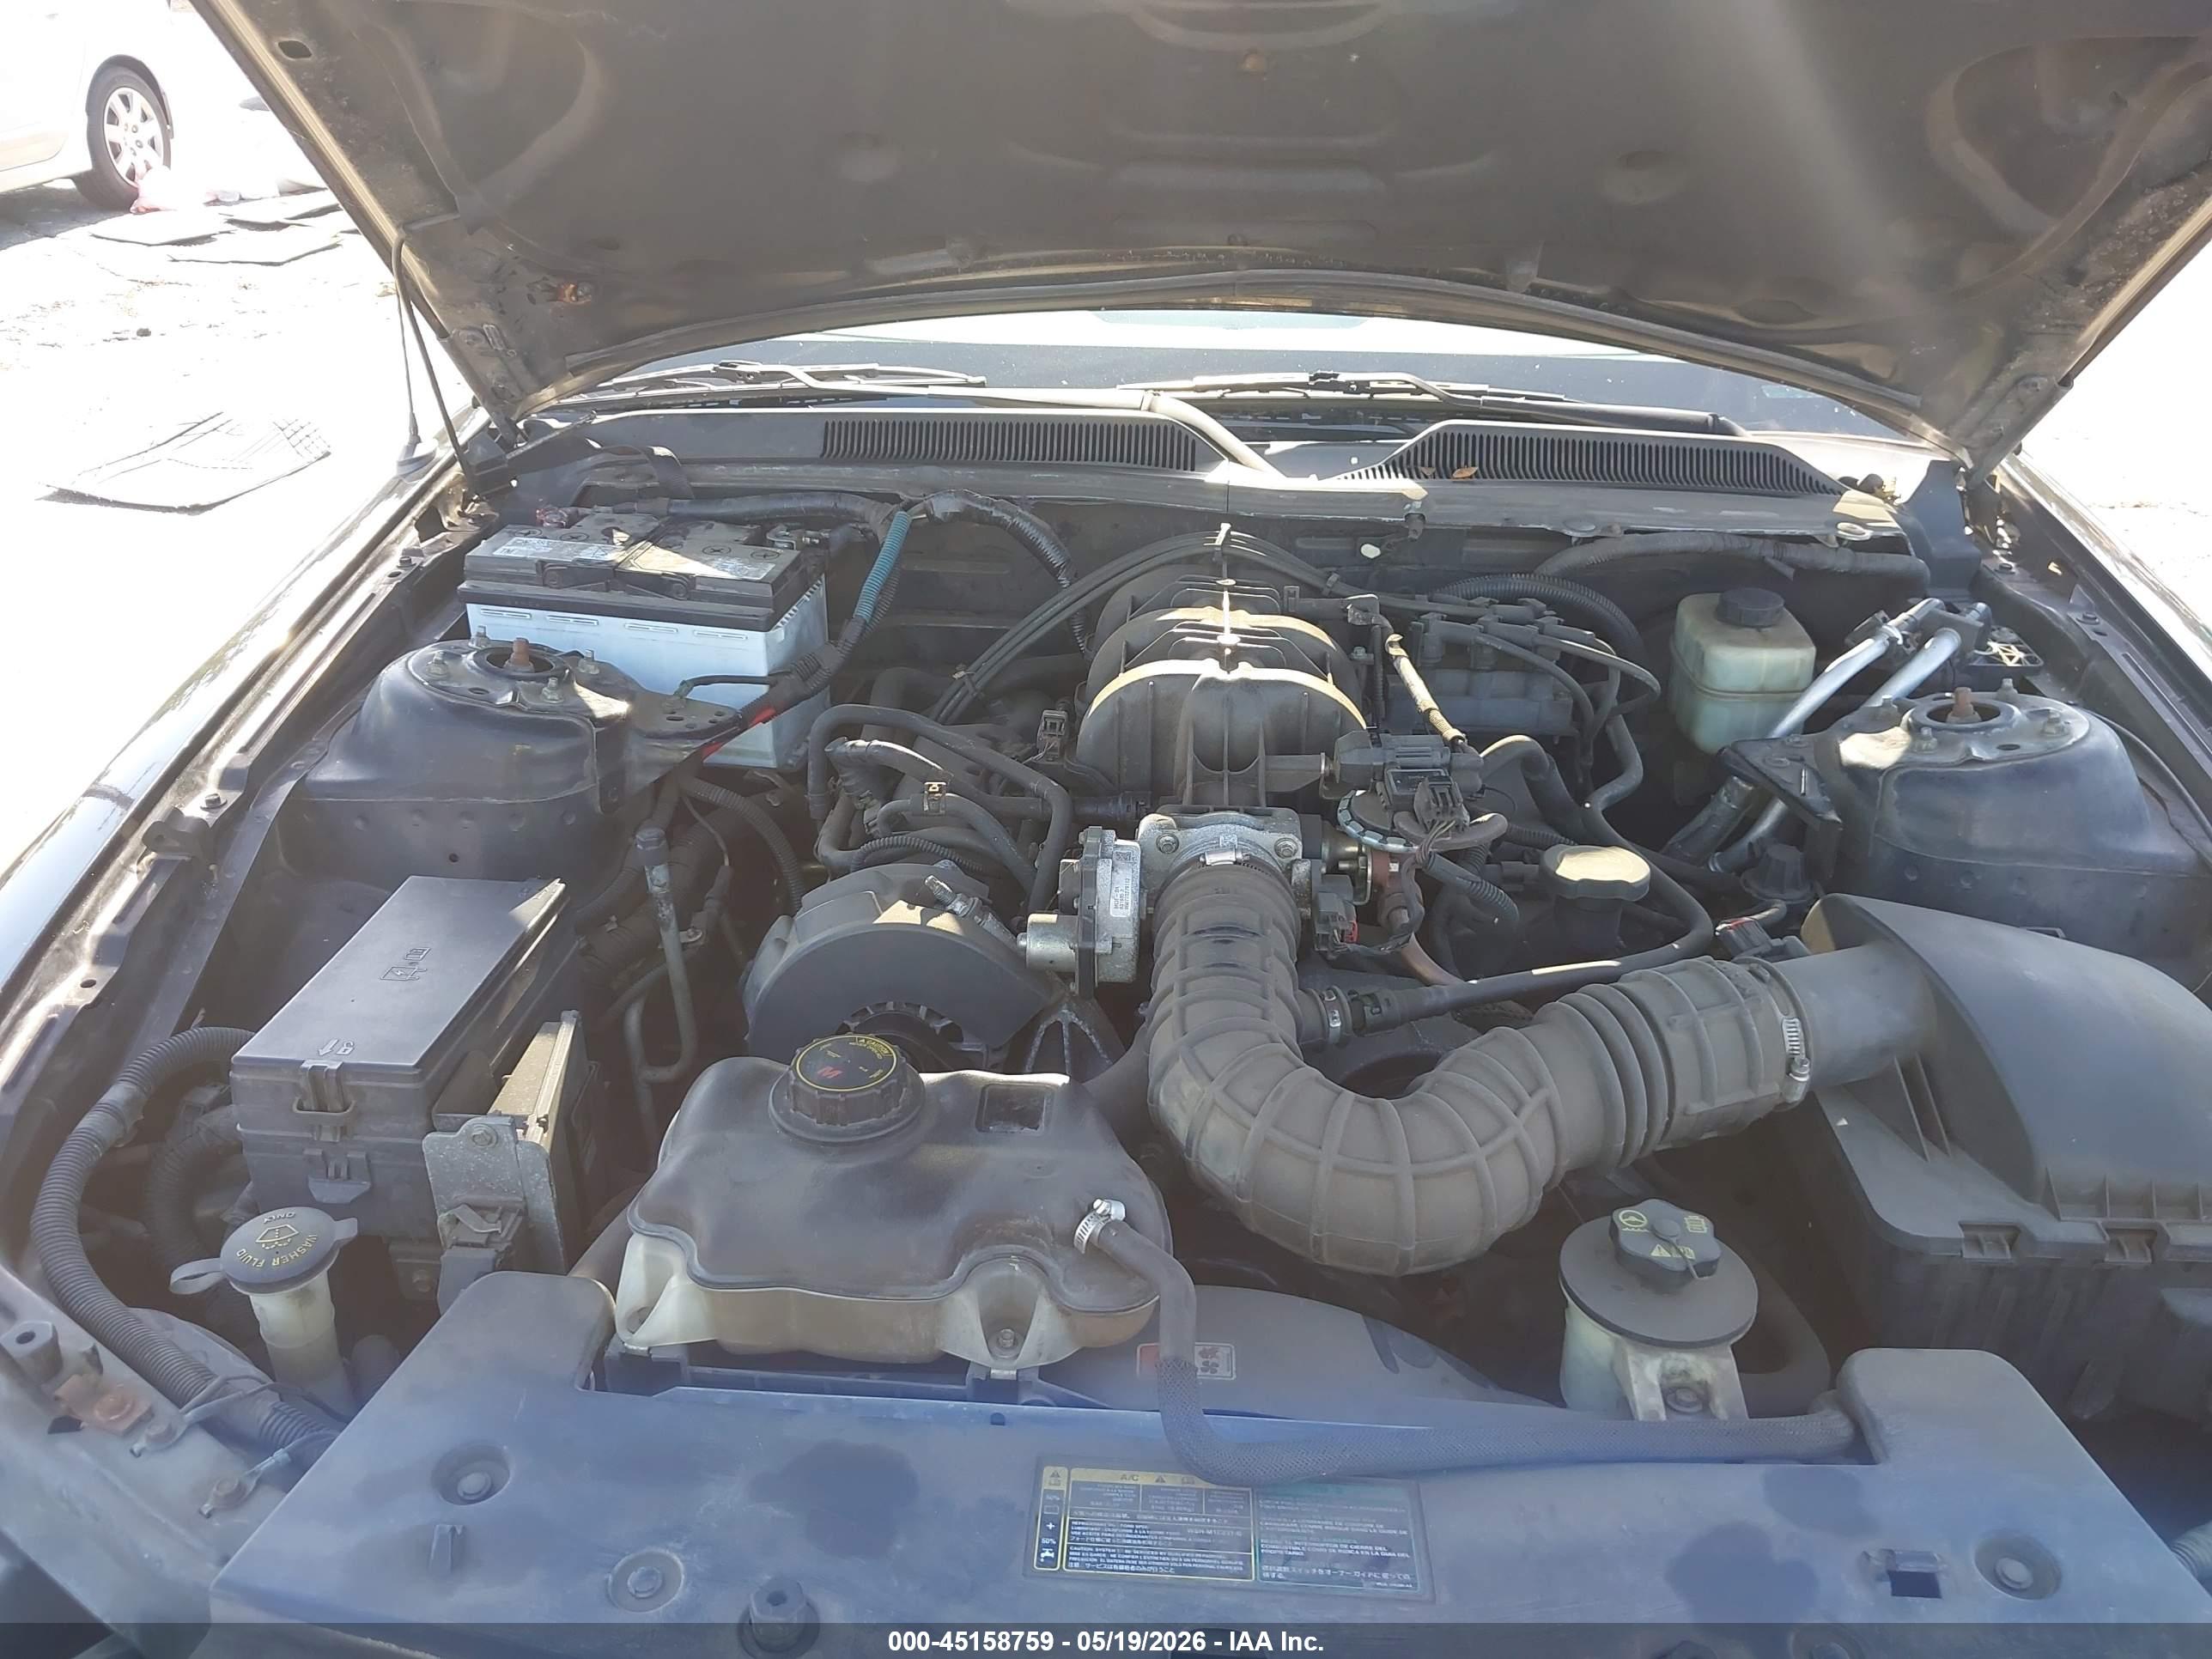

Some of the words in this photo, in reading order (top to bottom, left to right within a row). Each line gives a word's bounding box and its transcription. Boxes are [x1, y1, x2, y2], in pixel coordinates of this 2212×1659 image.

[263, 1212, 296, 1224] ONLY
[236, 1248, 265, 1268] FLUID
[270, 1233, 319, 1267] WASHER
[1120, 1474, 1139, 1482] A/C
